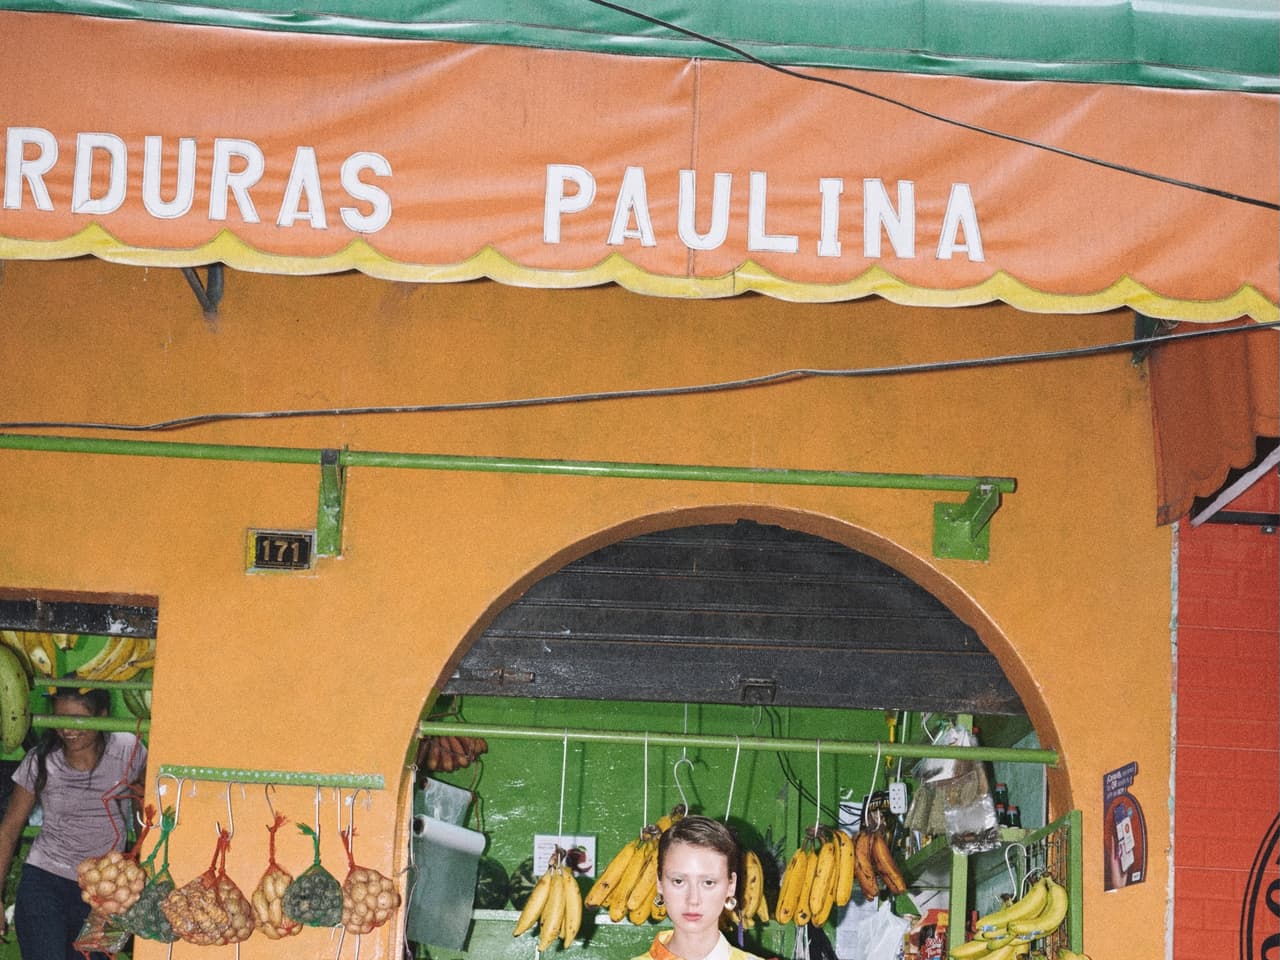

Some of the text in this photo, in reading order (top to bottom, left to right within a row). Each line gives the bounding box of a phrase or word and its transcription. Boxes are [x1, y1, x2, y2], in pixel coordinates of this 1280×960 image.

[3, 126, 984, 262] RDURAS PAULINA
[263, 540, 299, 562] 171
